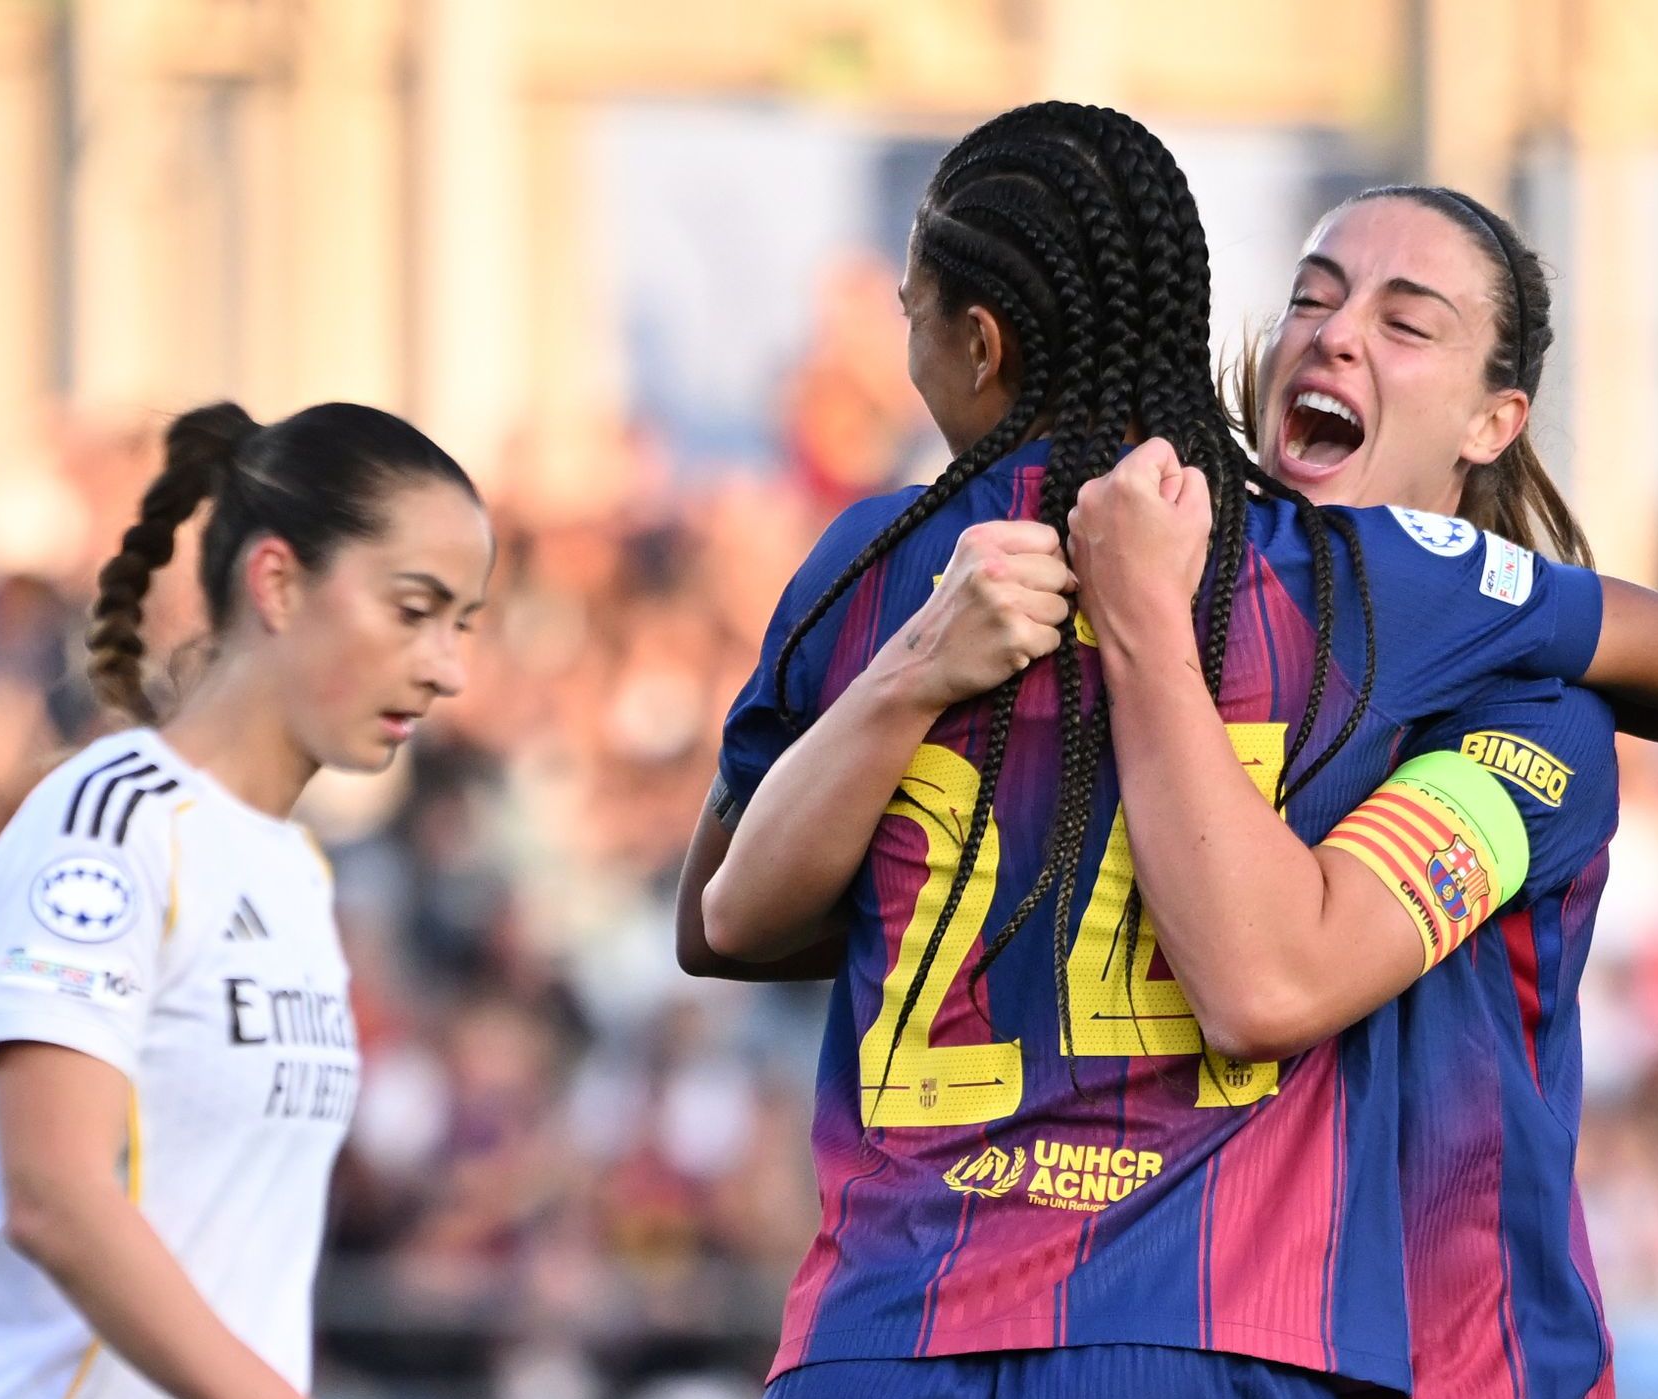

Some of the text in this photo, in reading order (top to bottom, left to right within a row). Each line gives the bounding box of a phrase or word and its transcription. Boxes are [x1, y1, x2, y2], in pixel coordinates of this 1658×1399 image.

[1460, 733, 1568, 802] BIMBO
[1398, 879, 1440, 949] CAPITANA
[1033, 1139, 1164, 1179] UNHCR
[1027, 1193, 1049, 1207] The
[1049, 1197, 1068, 1210] UN
